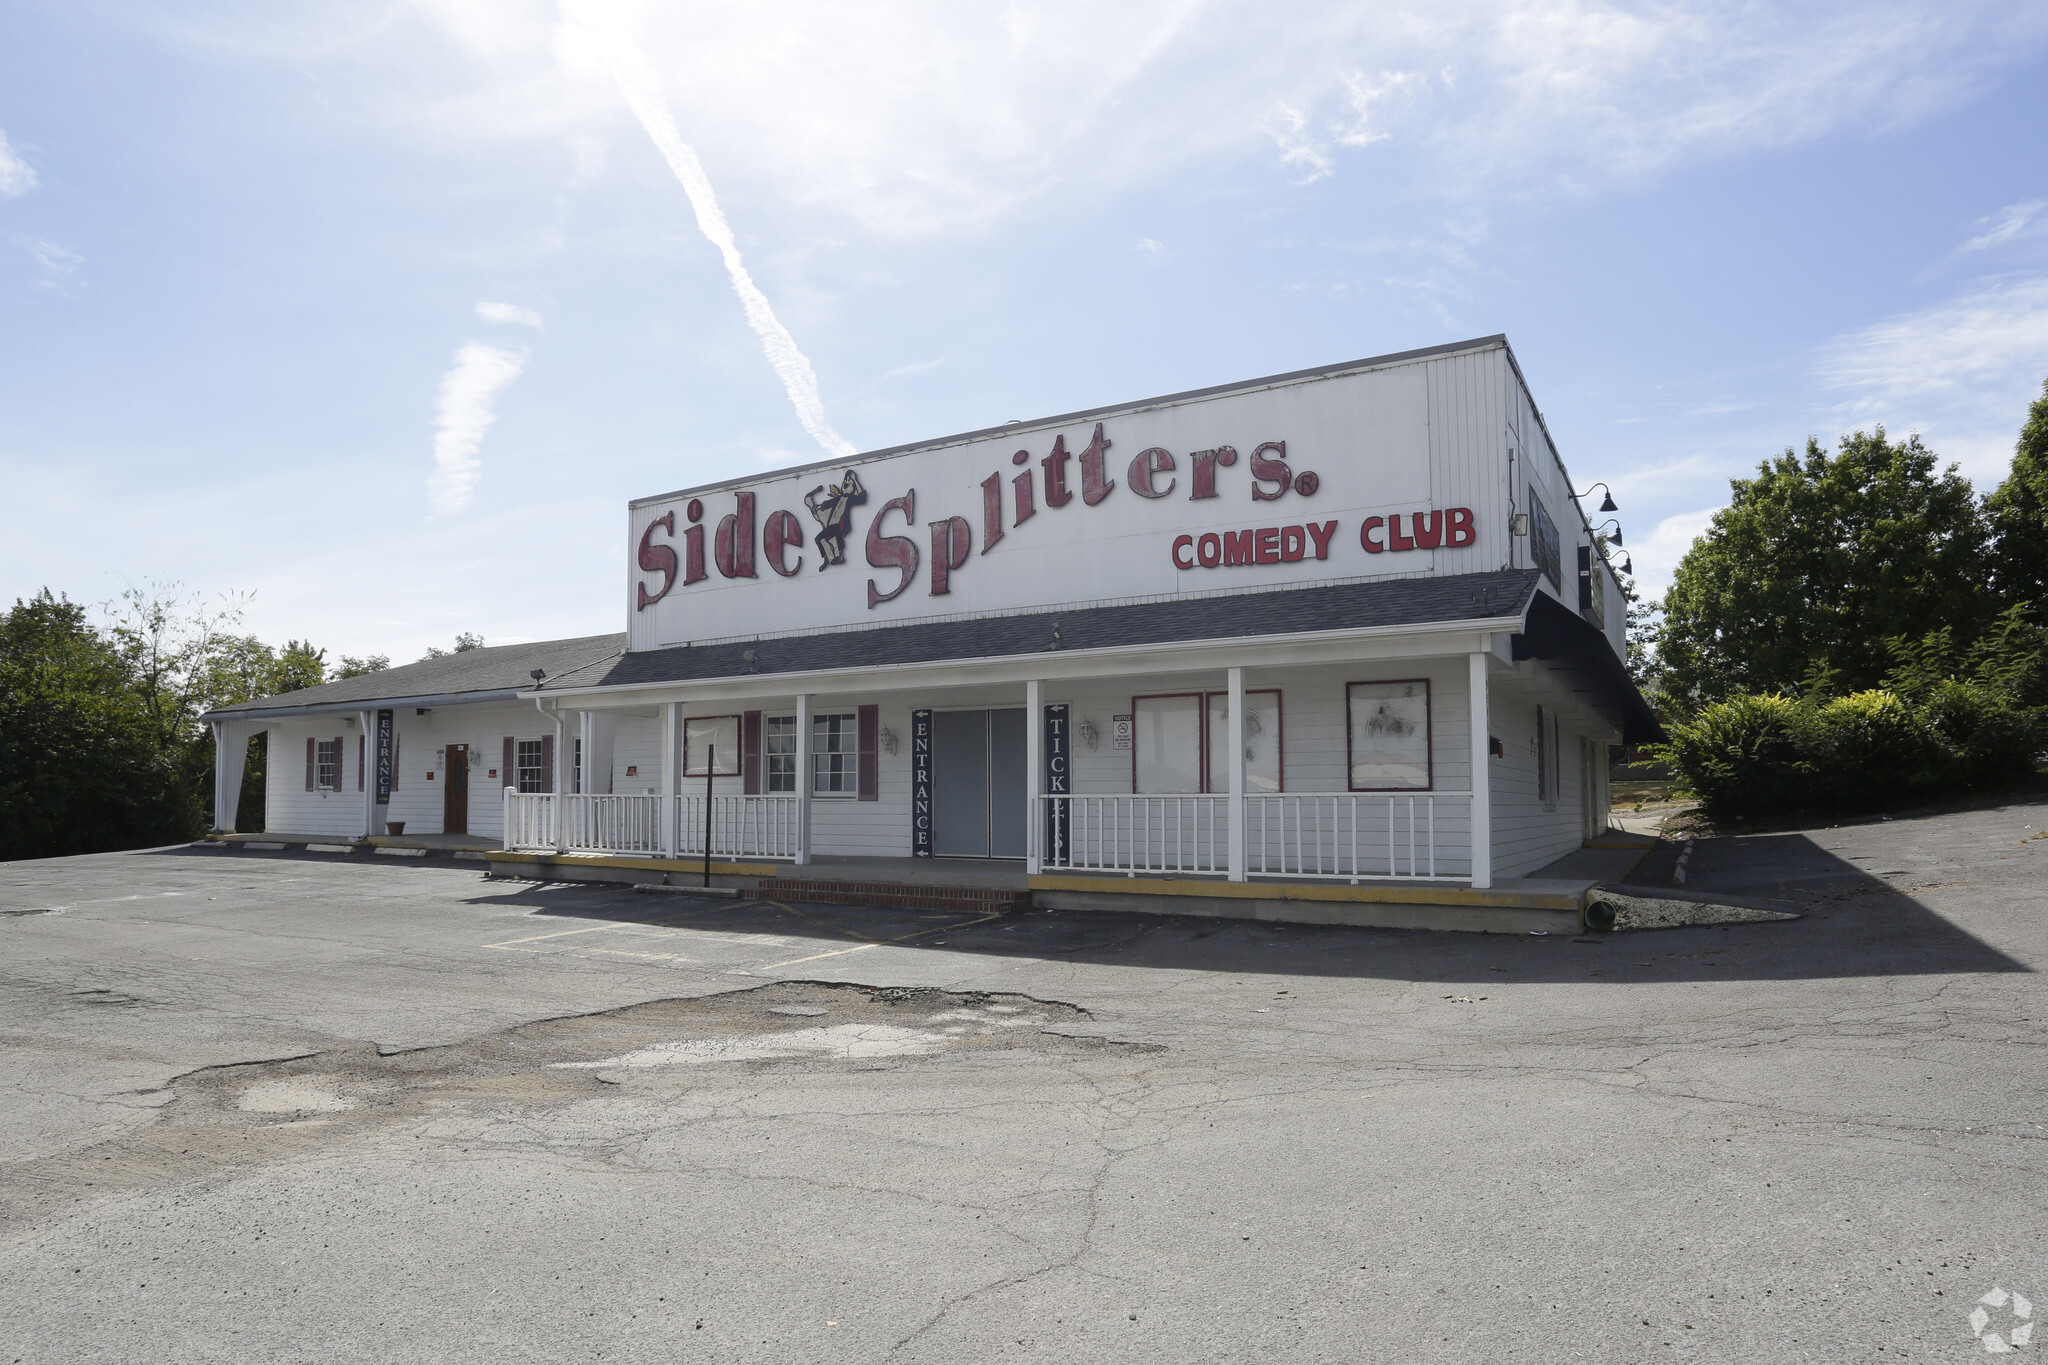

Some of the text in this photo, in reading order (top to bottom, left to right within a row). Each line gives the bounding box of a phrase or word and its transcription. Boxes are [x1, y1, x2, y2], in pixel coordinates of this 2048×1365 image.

[637, 491, 804, 612] Side
[1172, 507, 1476, 570] COMEDY CLUB
[379, 719, 390, 795] ENTRANCE
[915, 722, 929, 845] ENTRANCE
